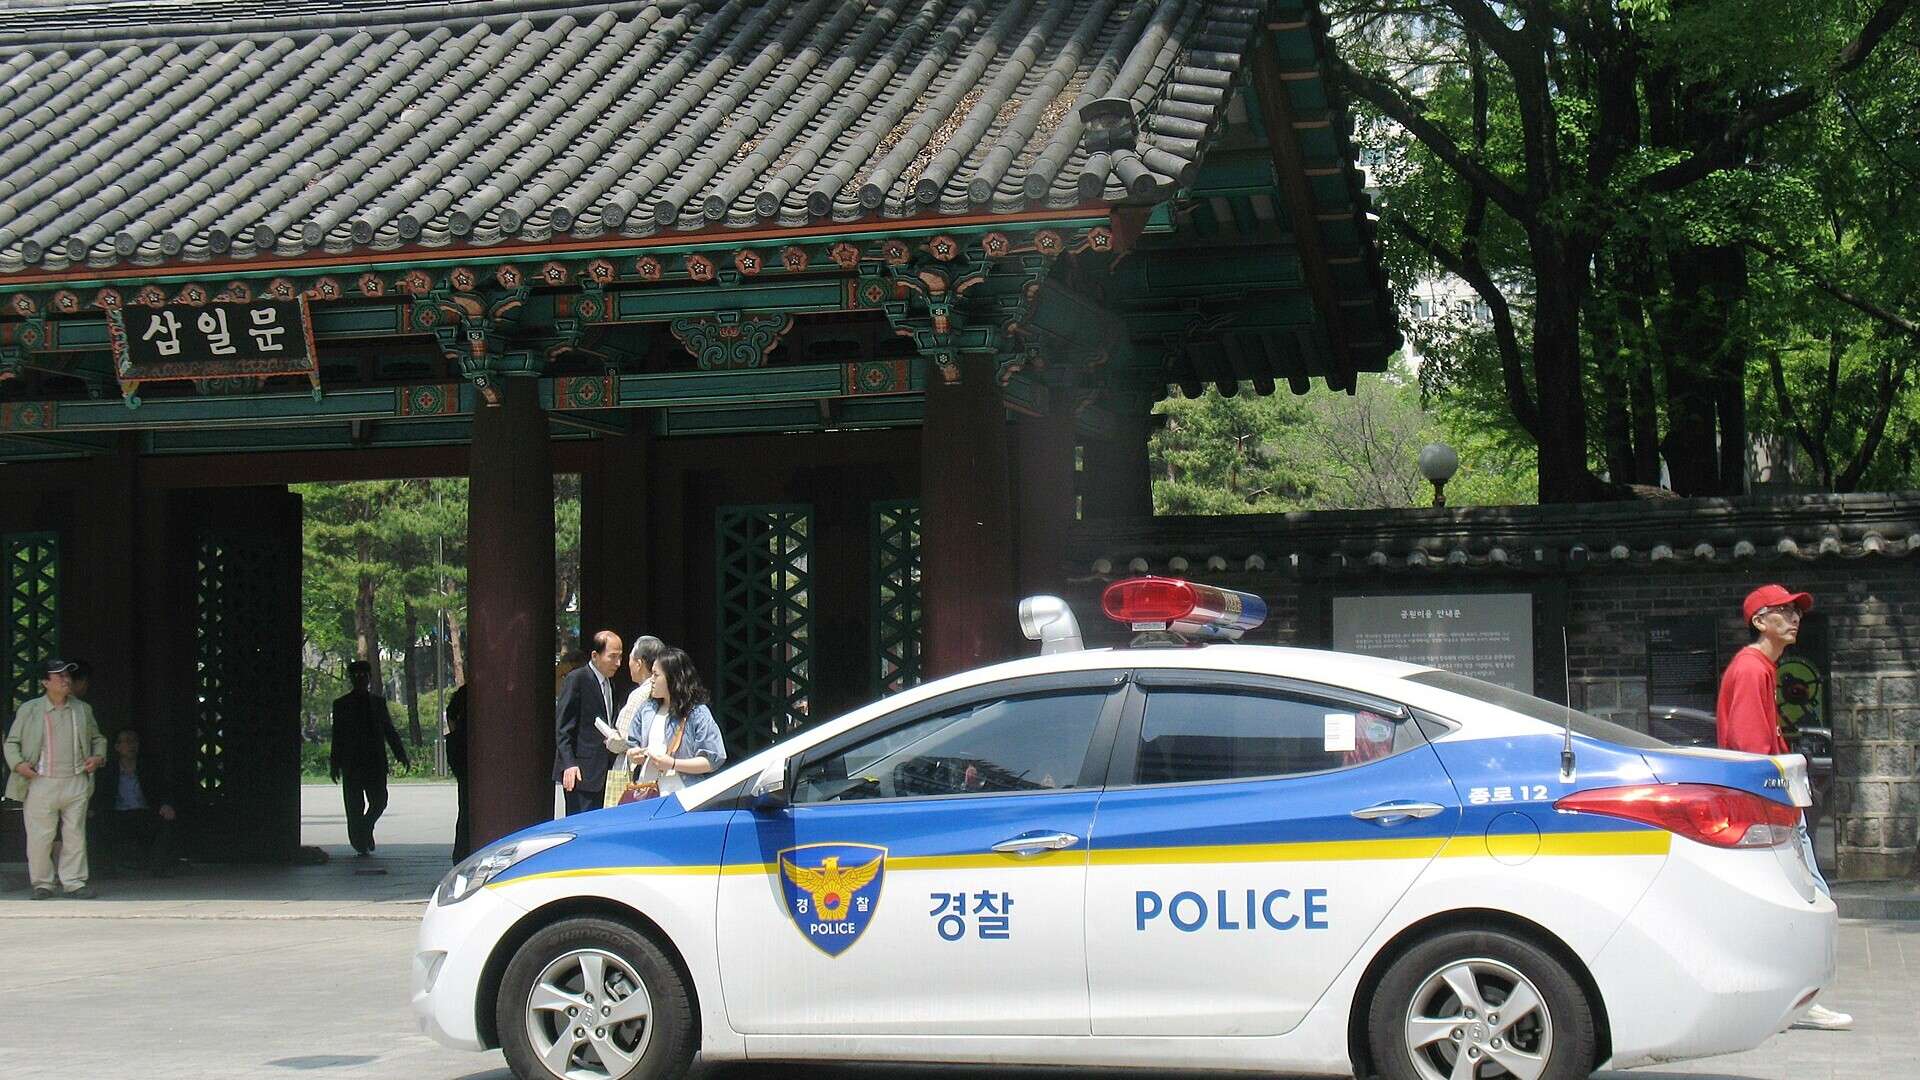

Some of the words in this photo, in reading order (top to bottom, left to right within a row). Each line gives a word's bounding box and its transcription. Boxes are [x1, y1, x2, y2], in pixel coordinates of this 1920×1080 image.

[142, 307, 286, 357] 삼일문
[1435, 608, 1462, 619] 안내문
[1468, 786, 1514, 805] 종로
[1520, 784, 1549, 801] 12
[796, 898, 809, 914] 경
[856, 896, 870, 912] 찰
[929, 889, 1015, 942] 경찰
[1135, 888, 1329, 933] POLICE
[810, 922, 856, 935] POLICE
